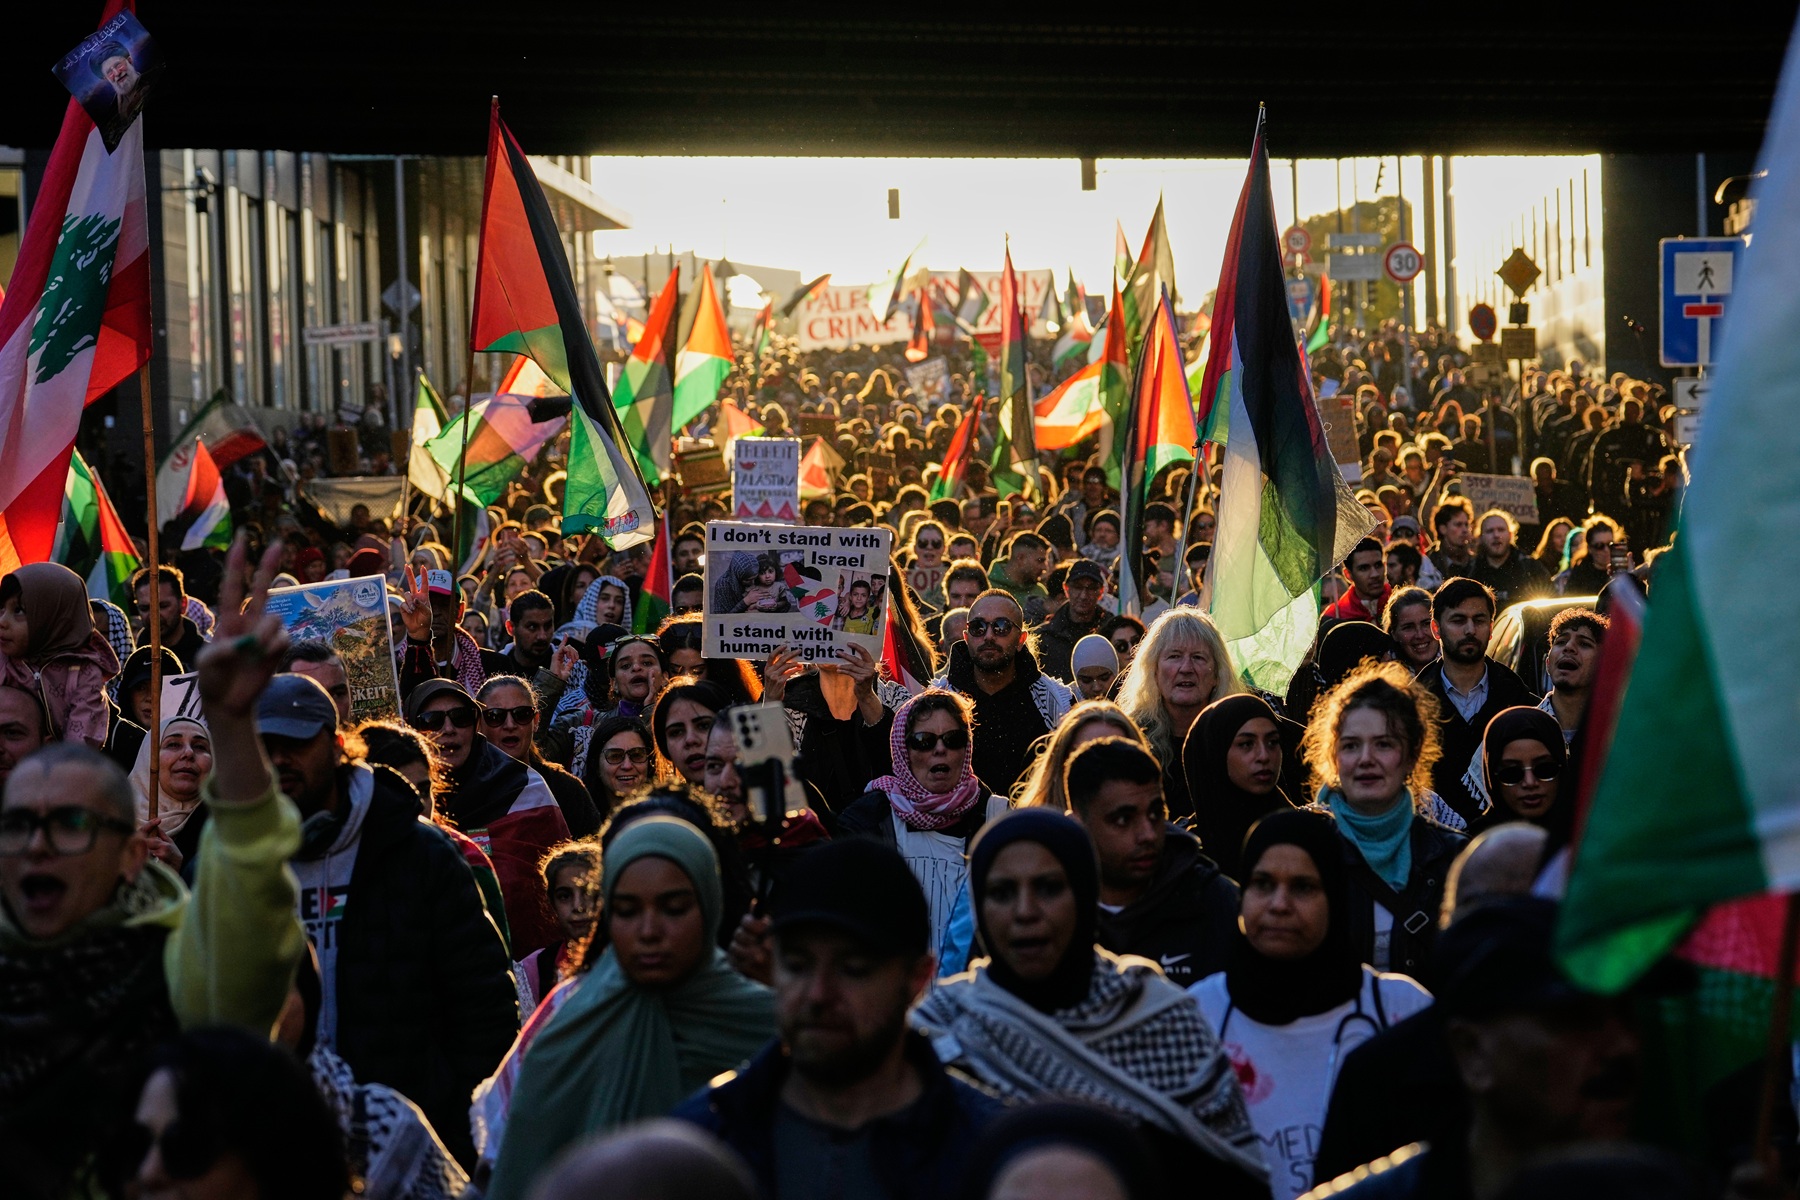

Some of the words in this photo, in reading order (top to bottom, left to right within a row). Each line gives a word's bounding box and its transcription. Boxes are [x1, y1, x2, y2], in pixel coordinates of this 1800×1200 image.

[1393, 254, 1416, 272] 30
[808, 313, 896, 342] CRIME
[1467, 476, 1492, 488] STOP
[711, 528, 717, 541] I
[778, 531, 832, 546] stand
[839, 533, 881, 548] with
[811, 551, 865, 568] Israel
[719, 624, 725, 637] I
[733, 624, 786, 639] stand
[792, 627, 834, 641] with
[720, 640, 781, 654] human
[791, 643, 845, 661] rights
[1164, 966, 1192, 975] AIR
